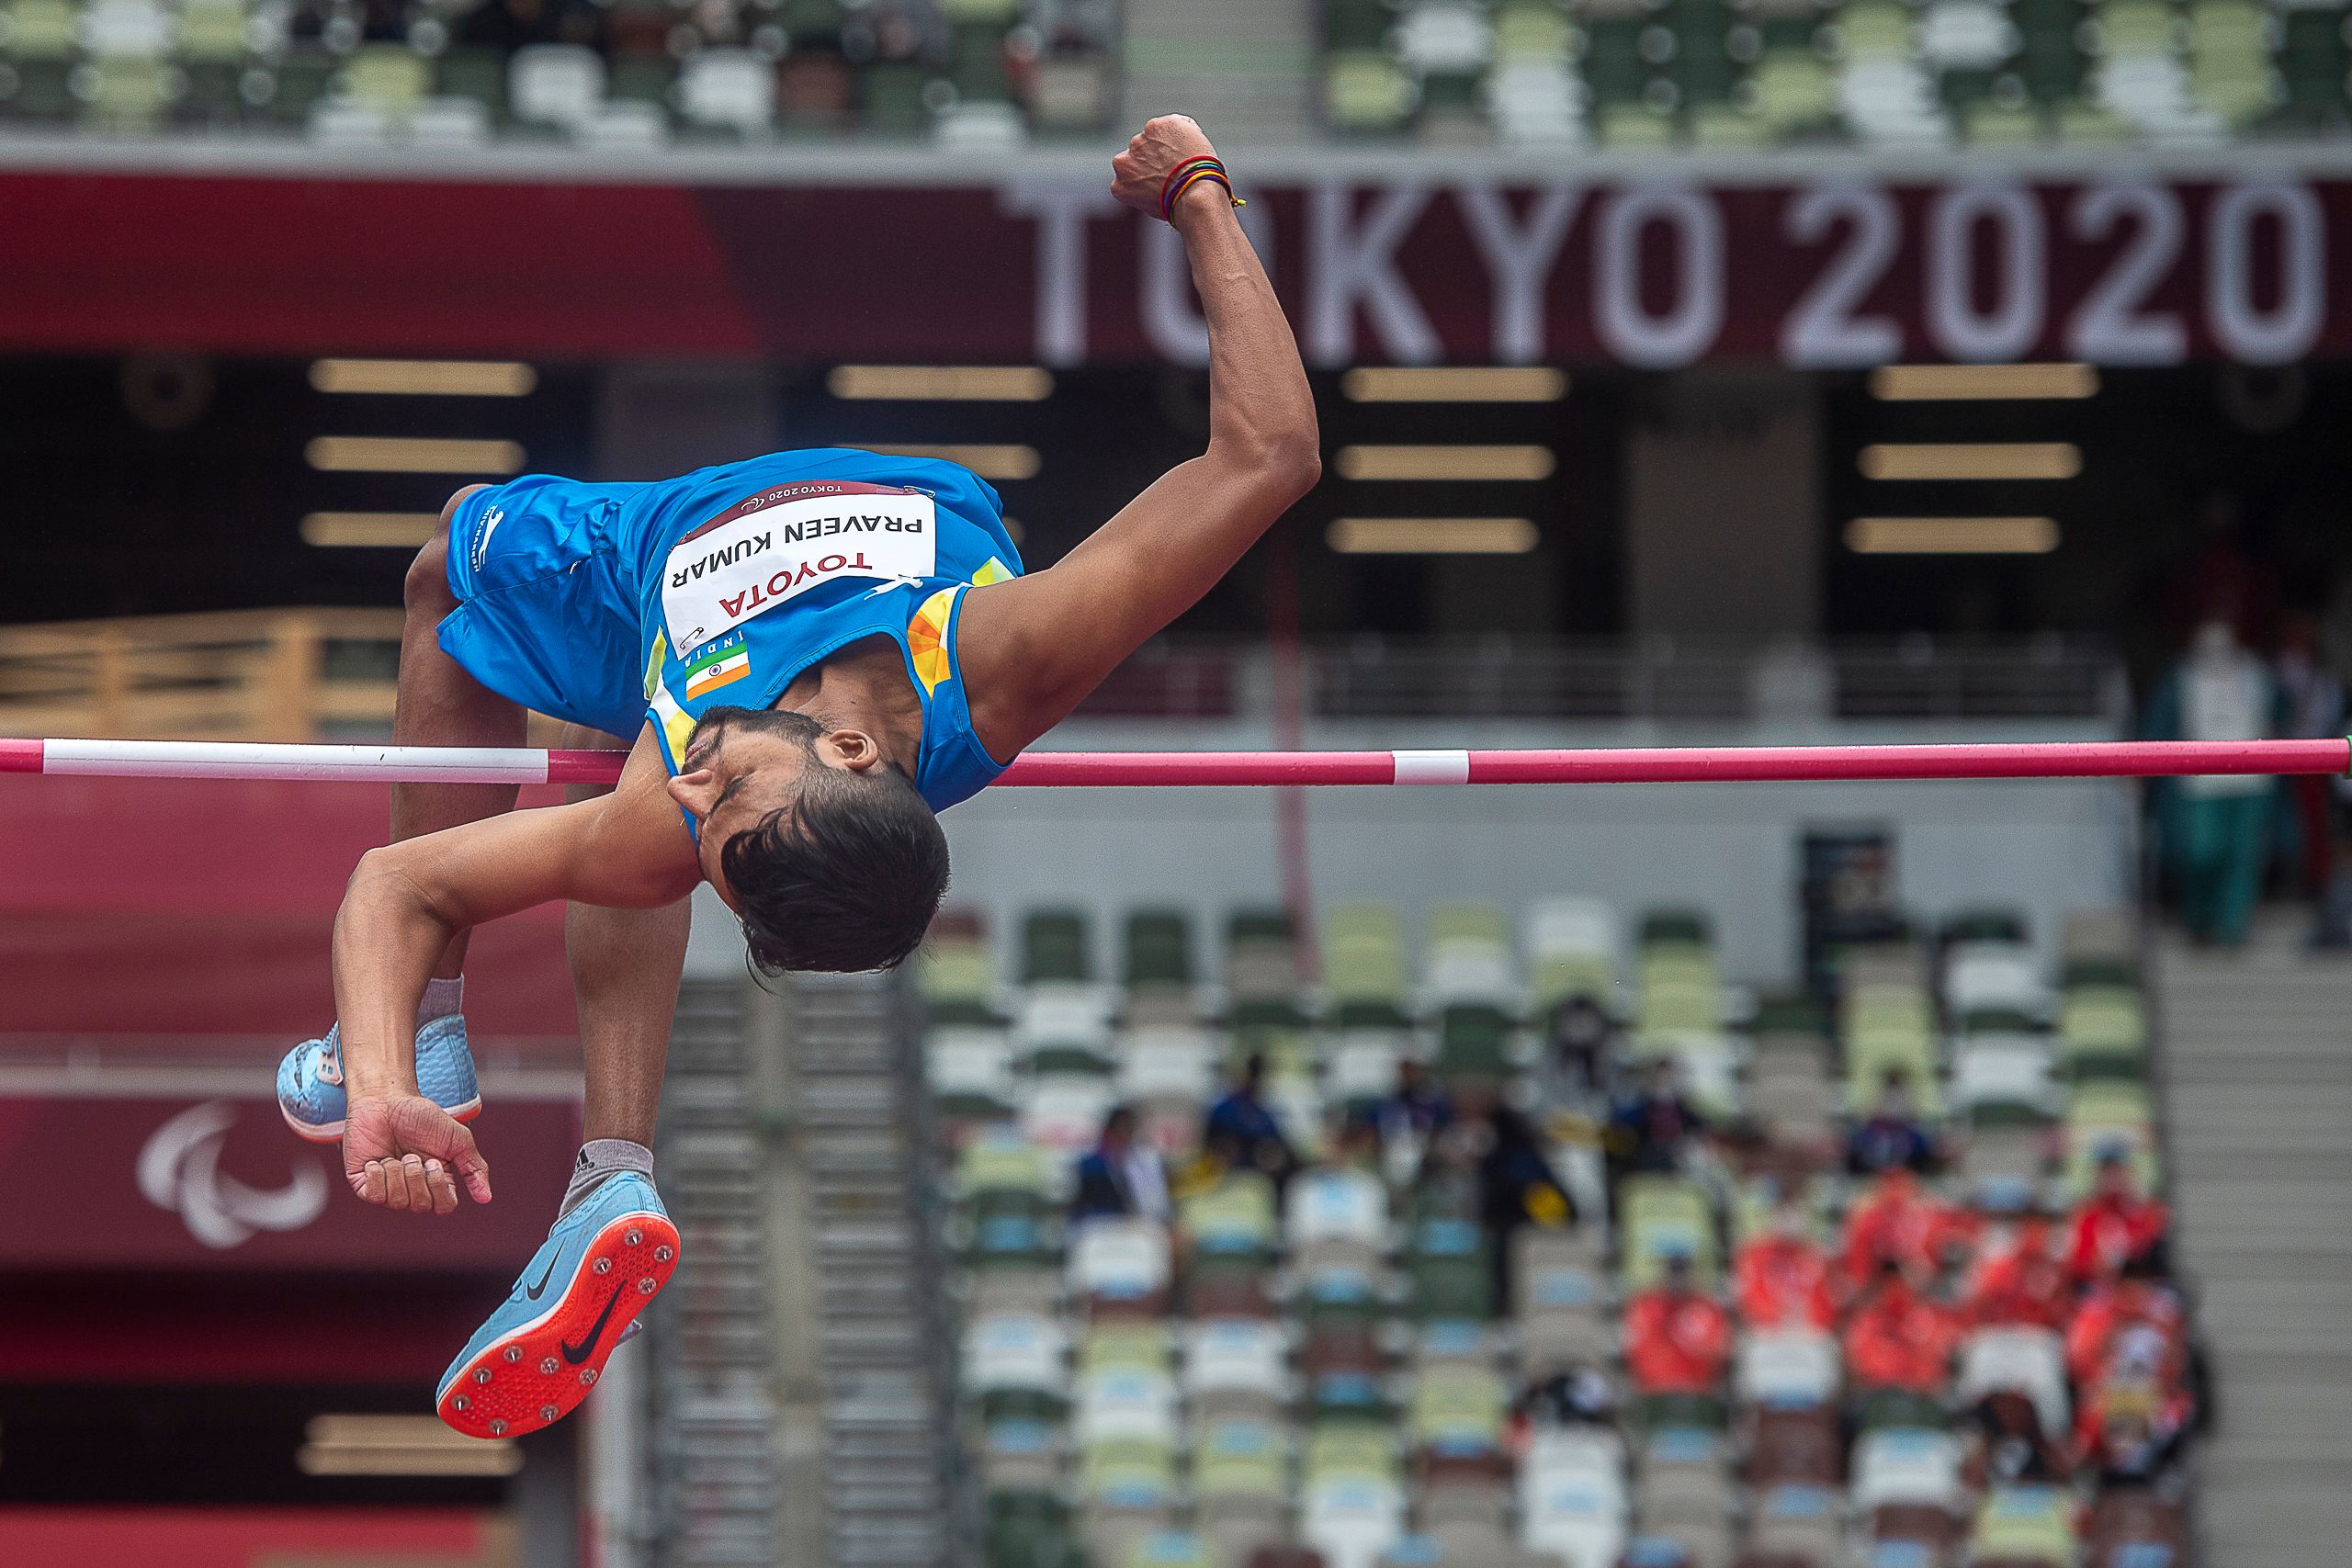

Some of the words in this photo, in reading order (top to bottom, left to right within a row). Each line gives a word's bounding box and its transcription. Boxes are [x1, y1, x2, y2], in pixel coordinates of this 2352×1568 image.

[1784, 180, 2326, 365] 2020
[768, 487, 798, 502] 2020
[801, 485, 842, 493] TOKYO
[785, 515, 922, 544] PRAVEEN
[672, 532, 771, 588] KUMAR
[719, 553, 872, 617] TOYOTA
[684, 629, 744, 668] INDIA
